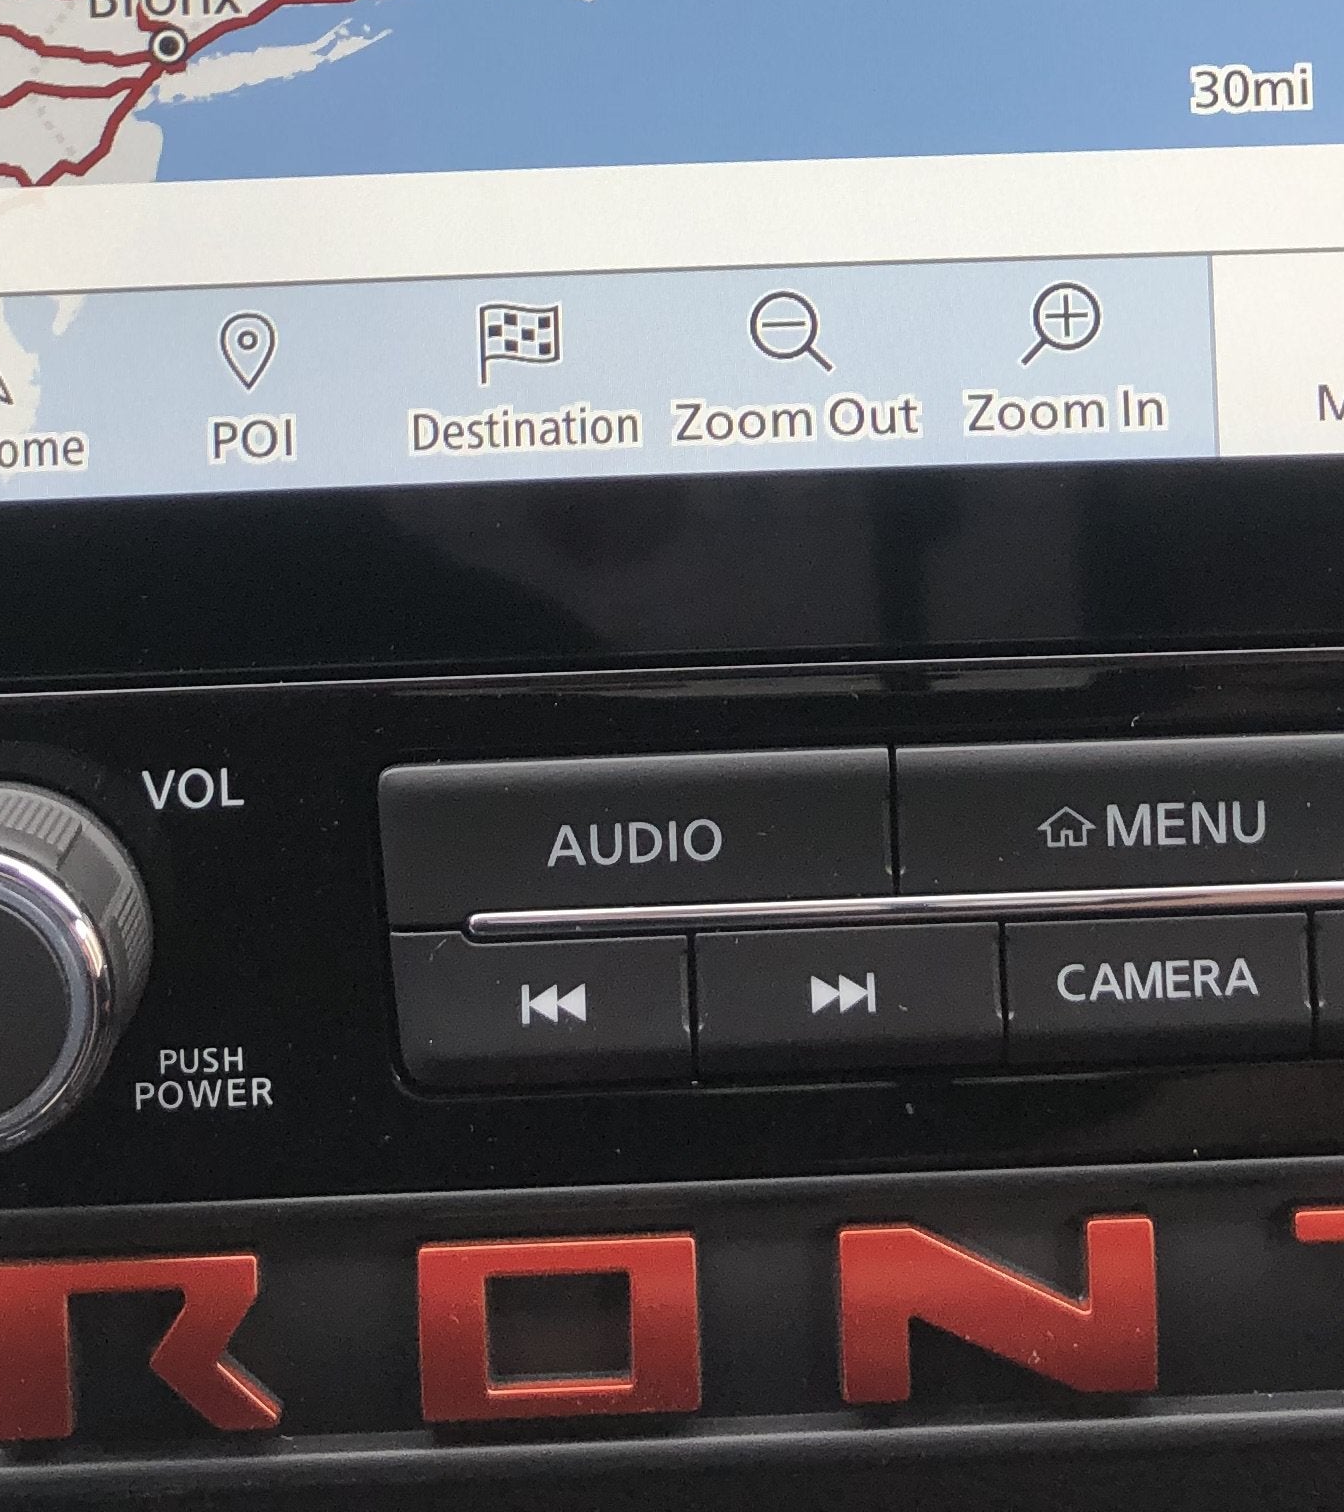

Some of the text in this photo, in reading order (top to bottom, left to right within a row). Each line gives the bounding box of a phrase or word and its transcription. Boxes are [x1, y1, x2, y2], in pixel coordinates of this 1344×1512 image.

[1193, 66, 1311, 110] 30mi
[412, 407, 640, 452] Destination
[674, 397, 919, 441] Zoom Out
[966, 389, 1165, 433] Zoom In
[212, 418, 294, 460] POI
[141, 767, 246, 810] VOL
[546, 819, 724, 868] AUDIO
[1105, 800, 1268, 848] MENU
[1056, 957, 1260, 1003] CAMERA
[159, 1046, 245, 1076] PUSH
[134, 1077, 274, 1111] POWER
